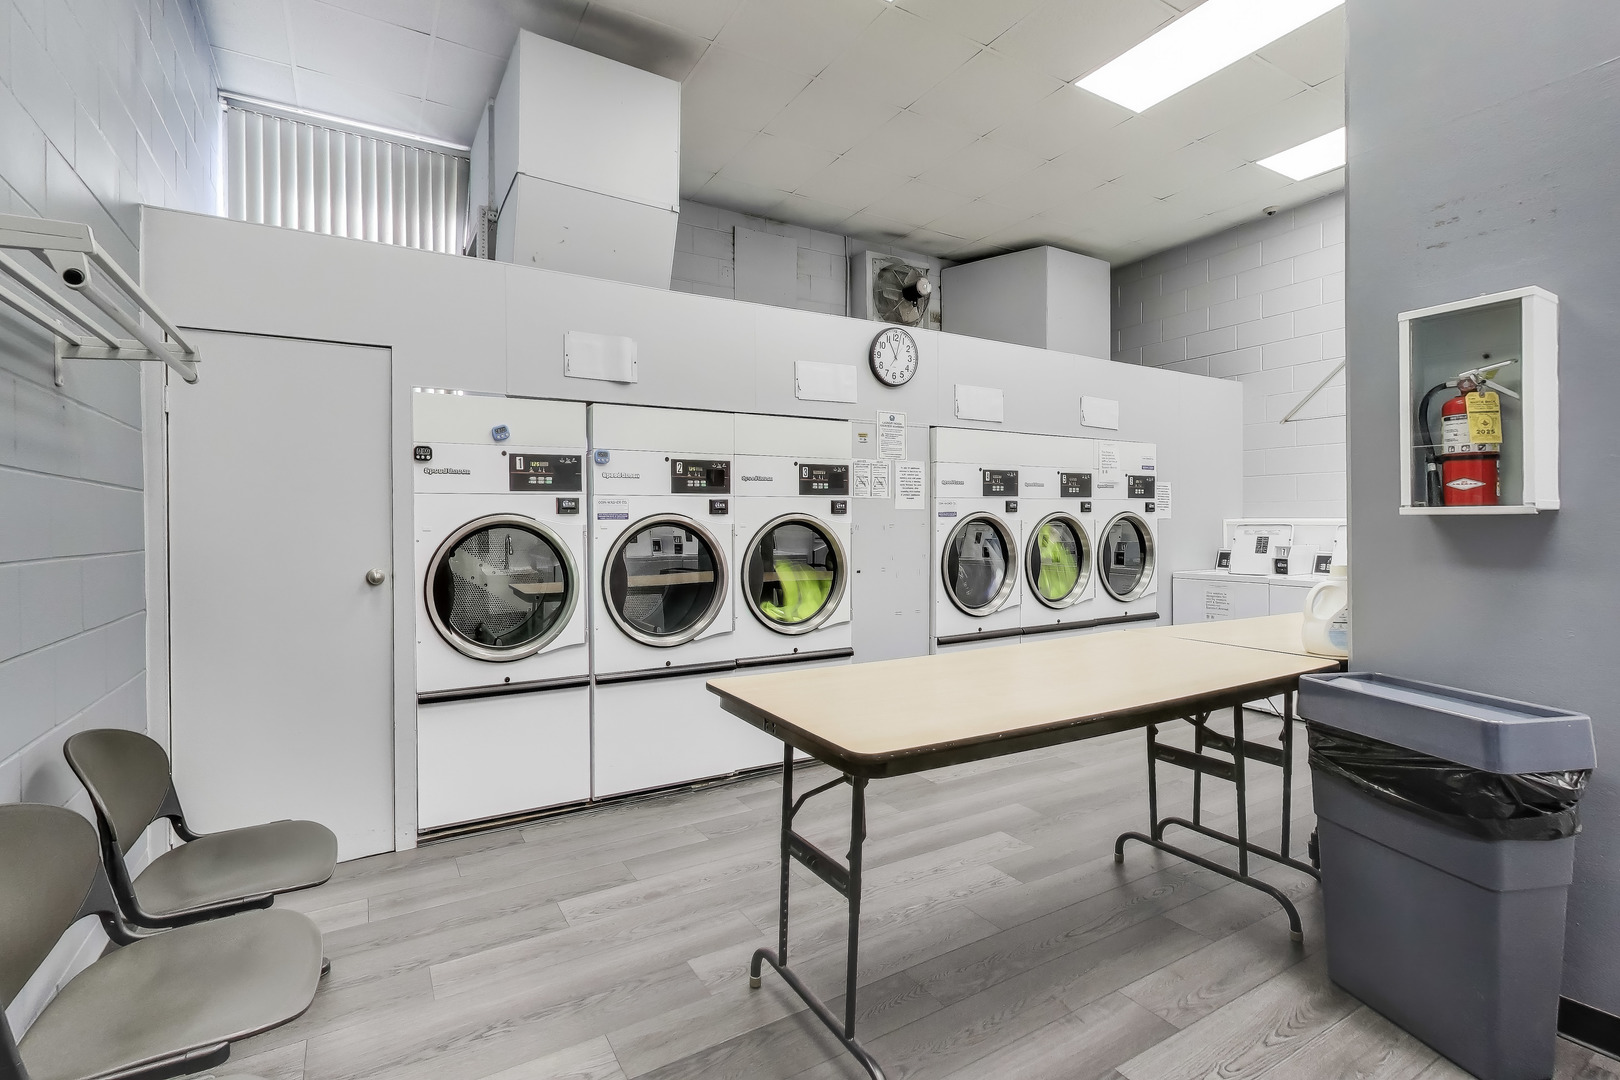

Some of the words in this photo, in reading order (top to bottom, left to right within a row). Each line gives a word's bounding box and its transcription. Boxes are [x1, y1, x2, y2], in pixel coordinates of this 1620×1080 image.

[892, 334, 899, 342] 12
[879, 341, 886, 350] 10
[879, 361, 884, 369] 8
[885, 369, 890, 377] 7
[892, 372, 897, 380] 6
[899, 370, 905, 378] 5
[678, 463, 682, 472] 2
[804, 468, 807, 476] 3
